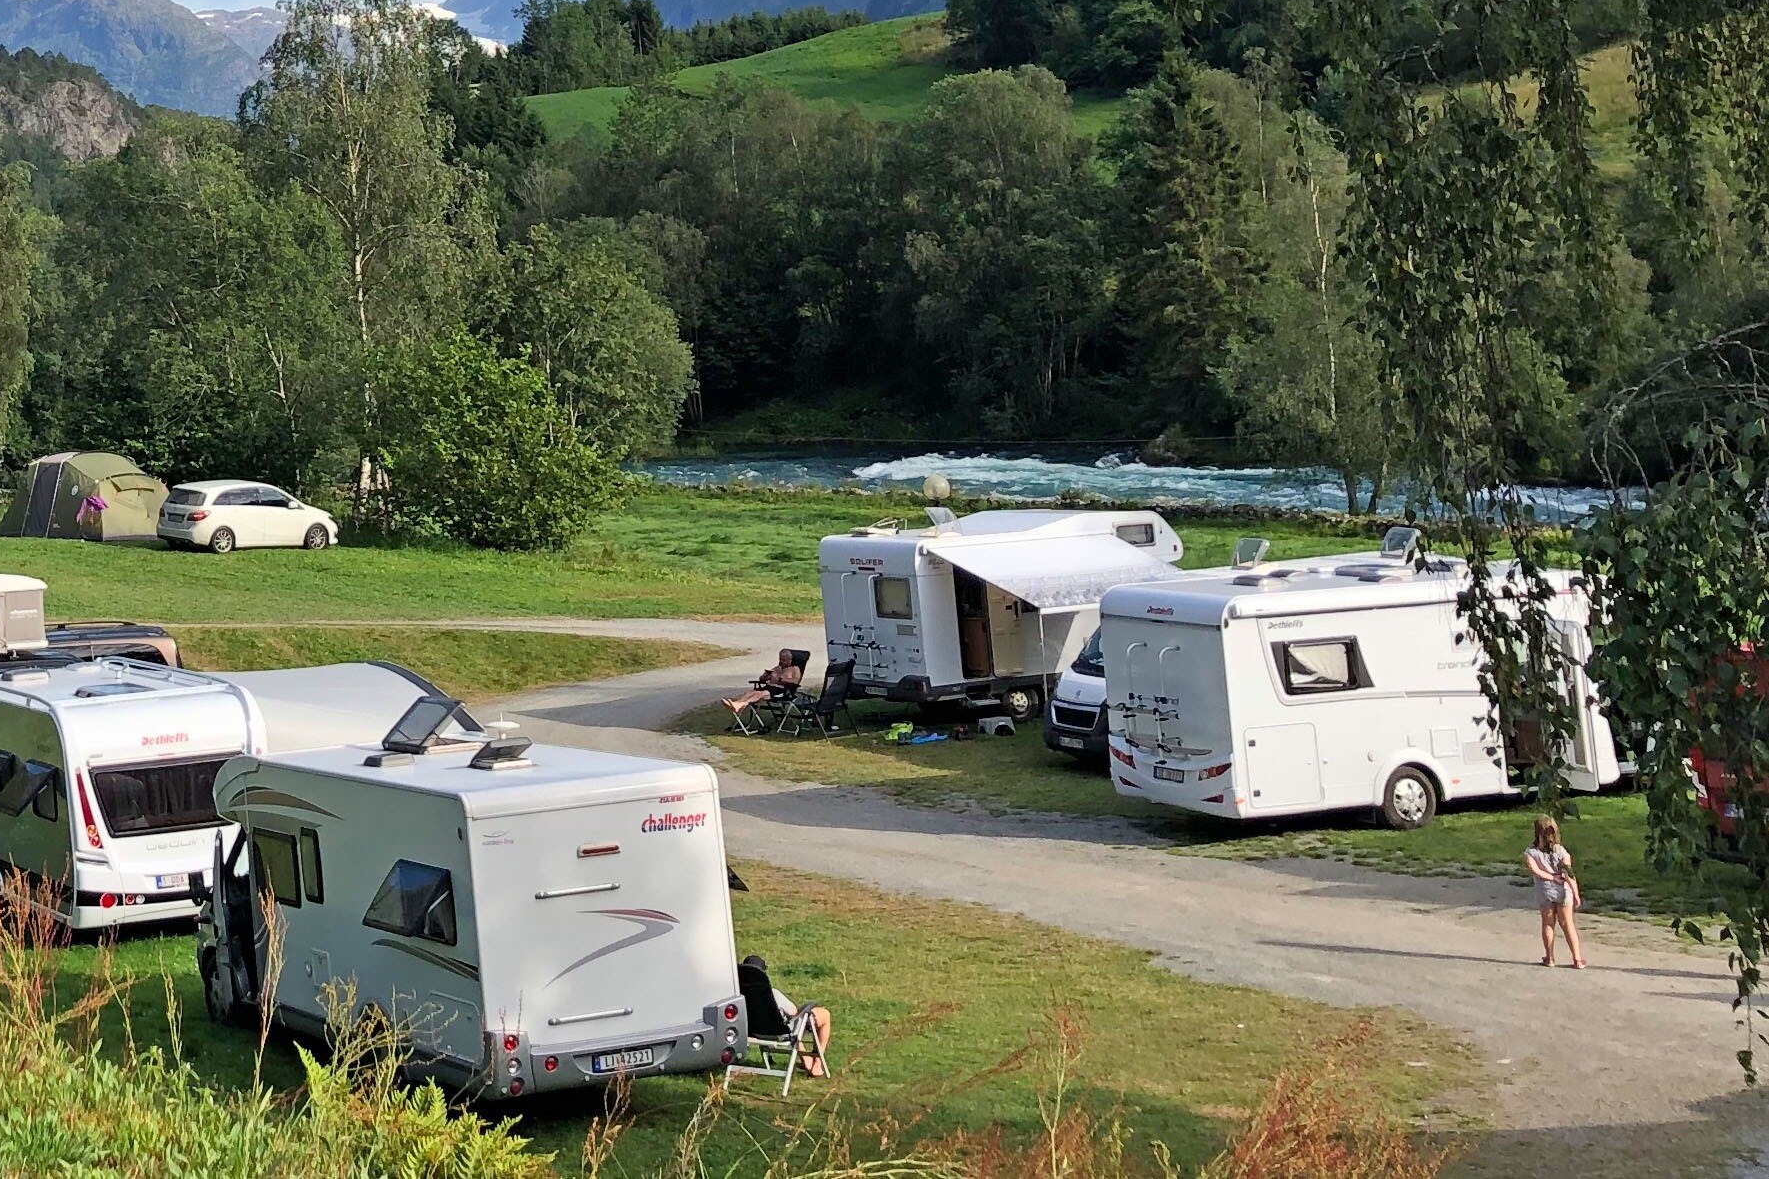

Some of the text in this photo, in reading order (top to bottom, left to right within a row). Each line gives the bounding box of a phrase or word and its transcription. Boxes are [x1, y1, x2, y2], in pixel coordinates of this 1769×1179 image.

[849, 557, 884, 566] SOLIFER
[1267, 620, 1304, 630] Dethleffs
[141, 732, 190, 746] Dethleffs
[641, 812, 707, 833] challenger
